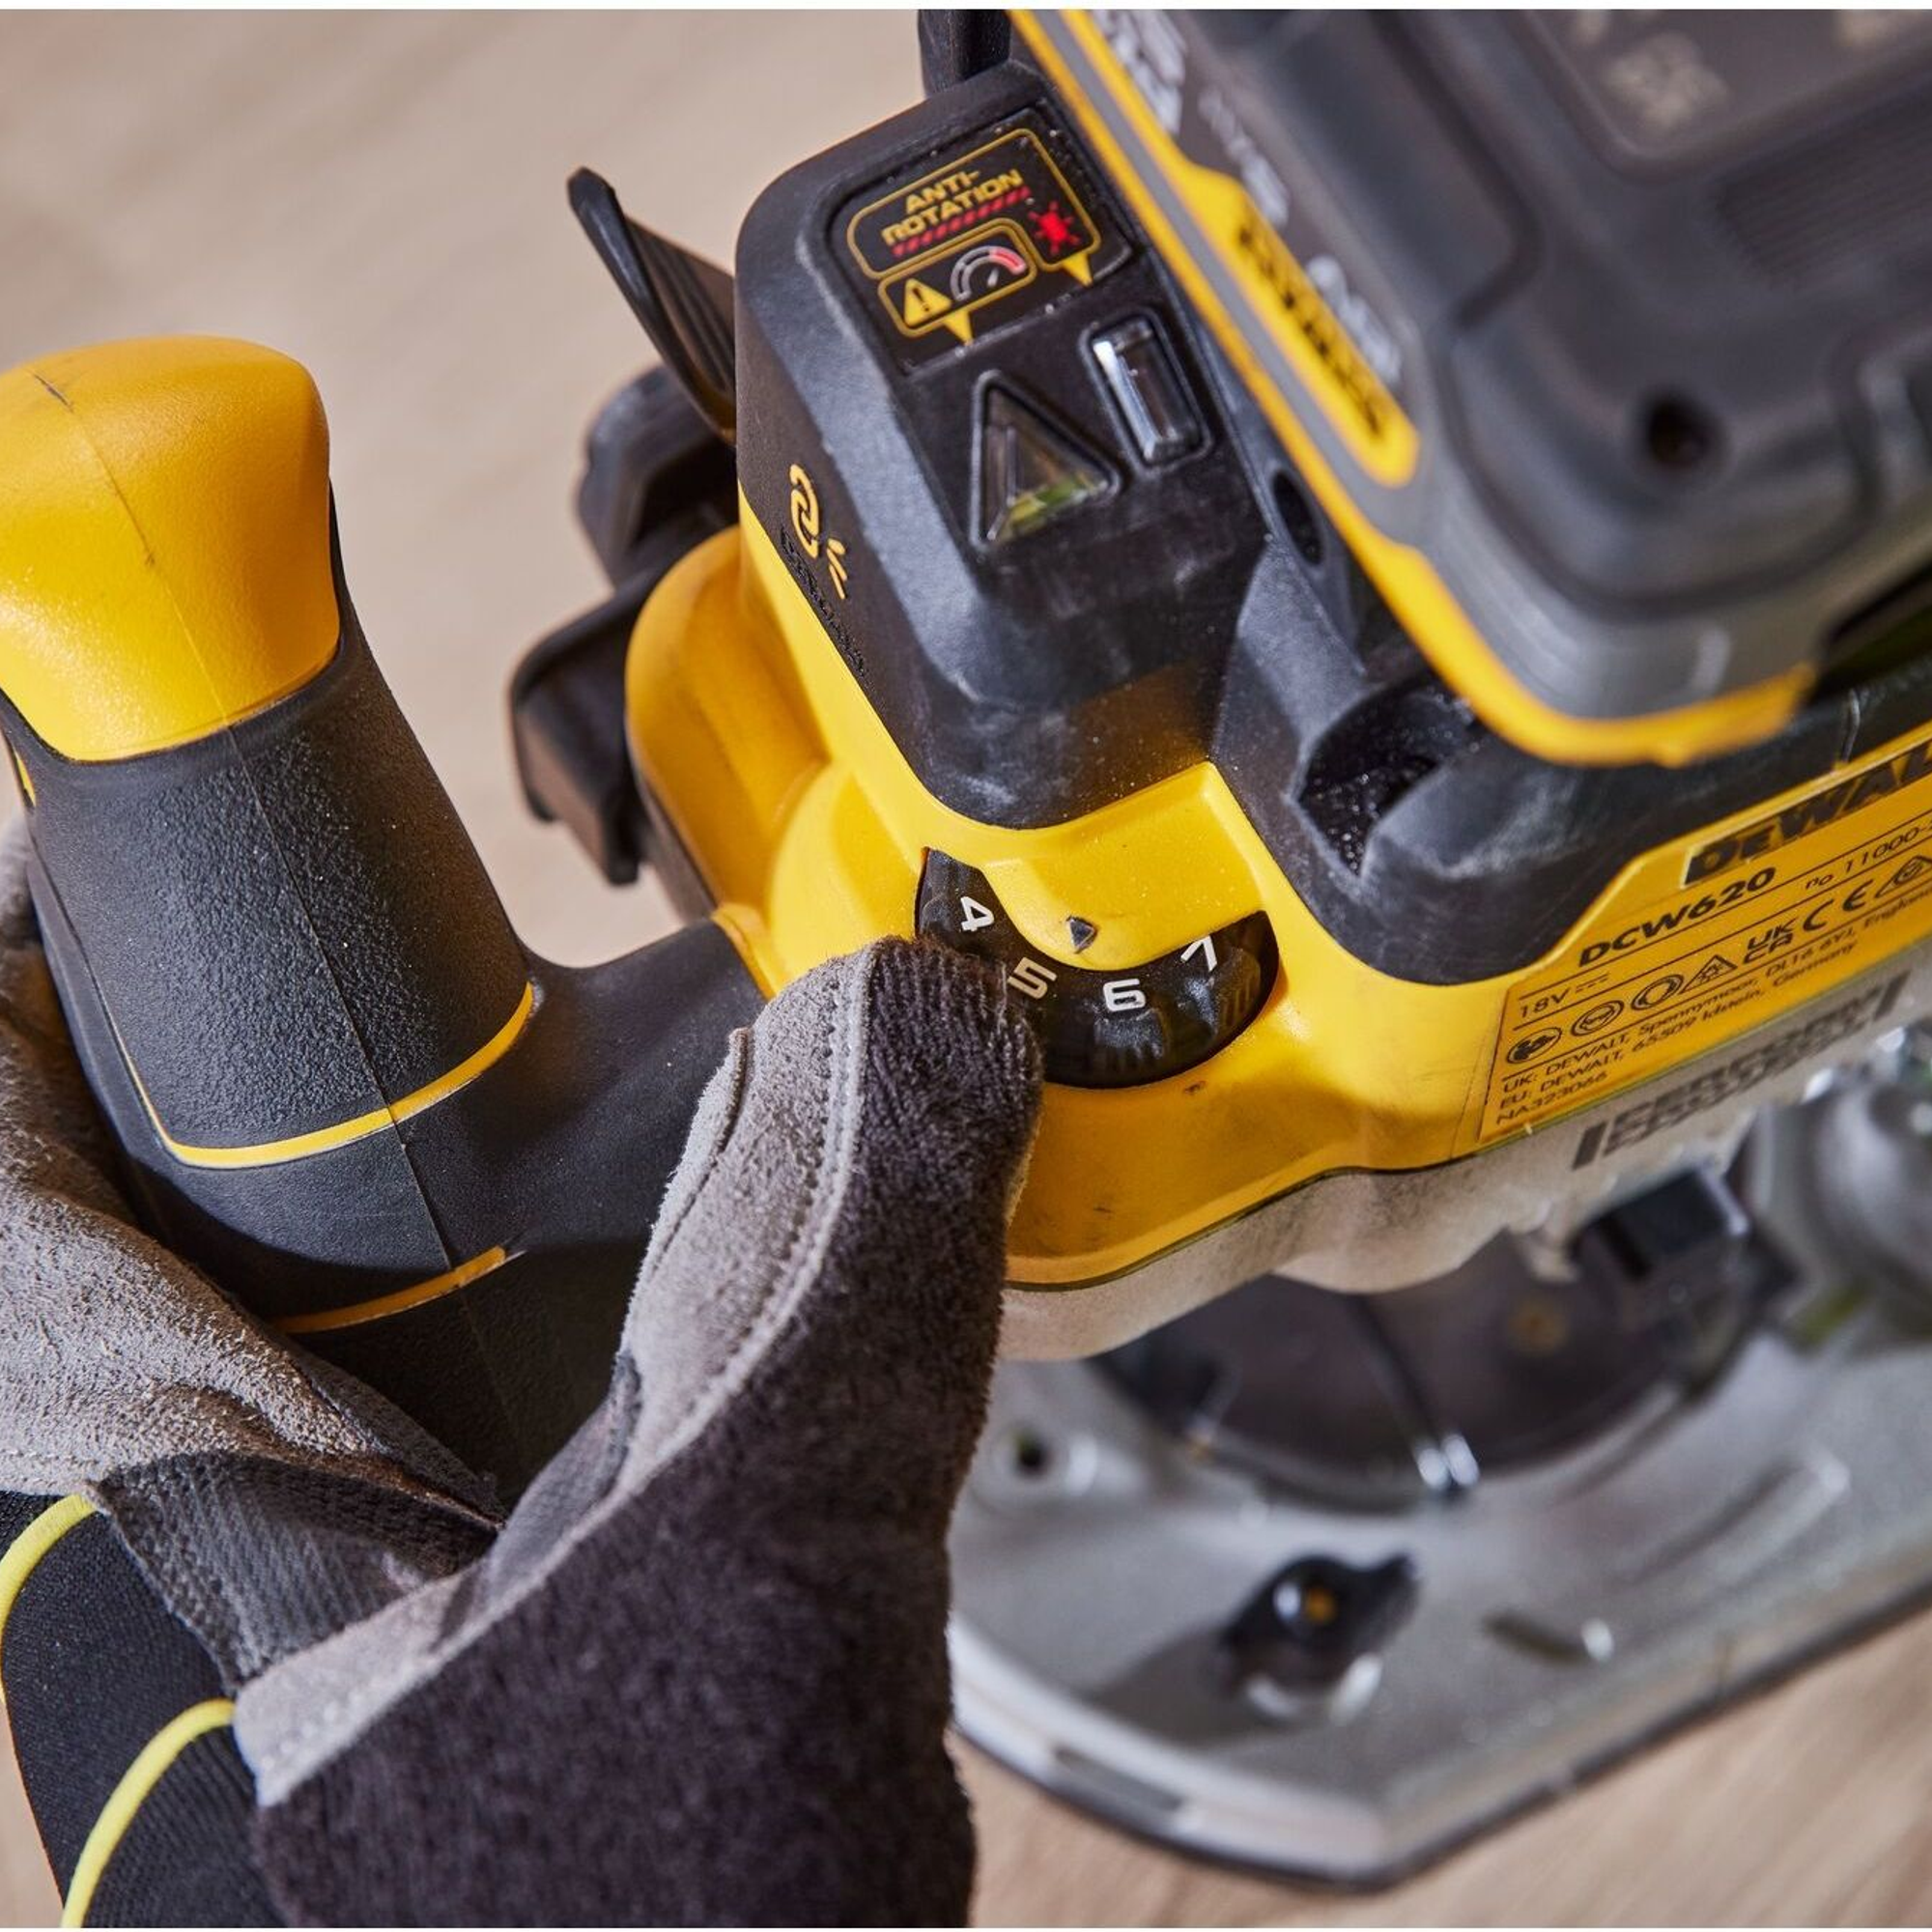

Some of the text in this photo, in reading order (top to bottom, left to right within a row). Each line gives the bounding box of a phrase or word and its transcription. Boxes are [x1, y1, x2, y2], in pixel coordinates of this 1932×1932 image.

[881, 168, 1024, 246] ROTATION
[905, 171, 980, 214] ANTI-
[1685, 739, 1932, 885] DEWAL
[1846, 824, 1932, 873] 11000-
[960, 895, 1217, 1012] 4 5 6 7
[1578, 867, 1776, 967] DCW620
